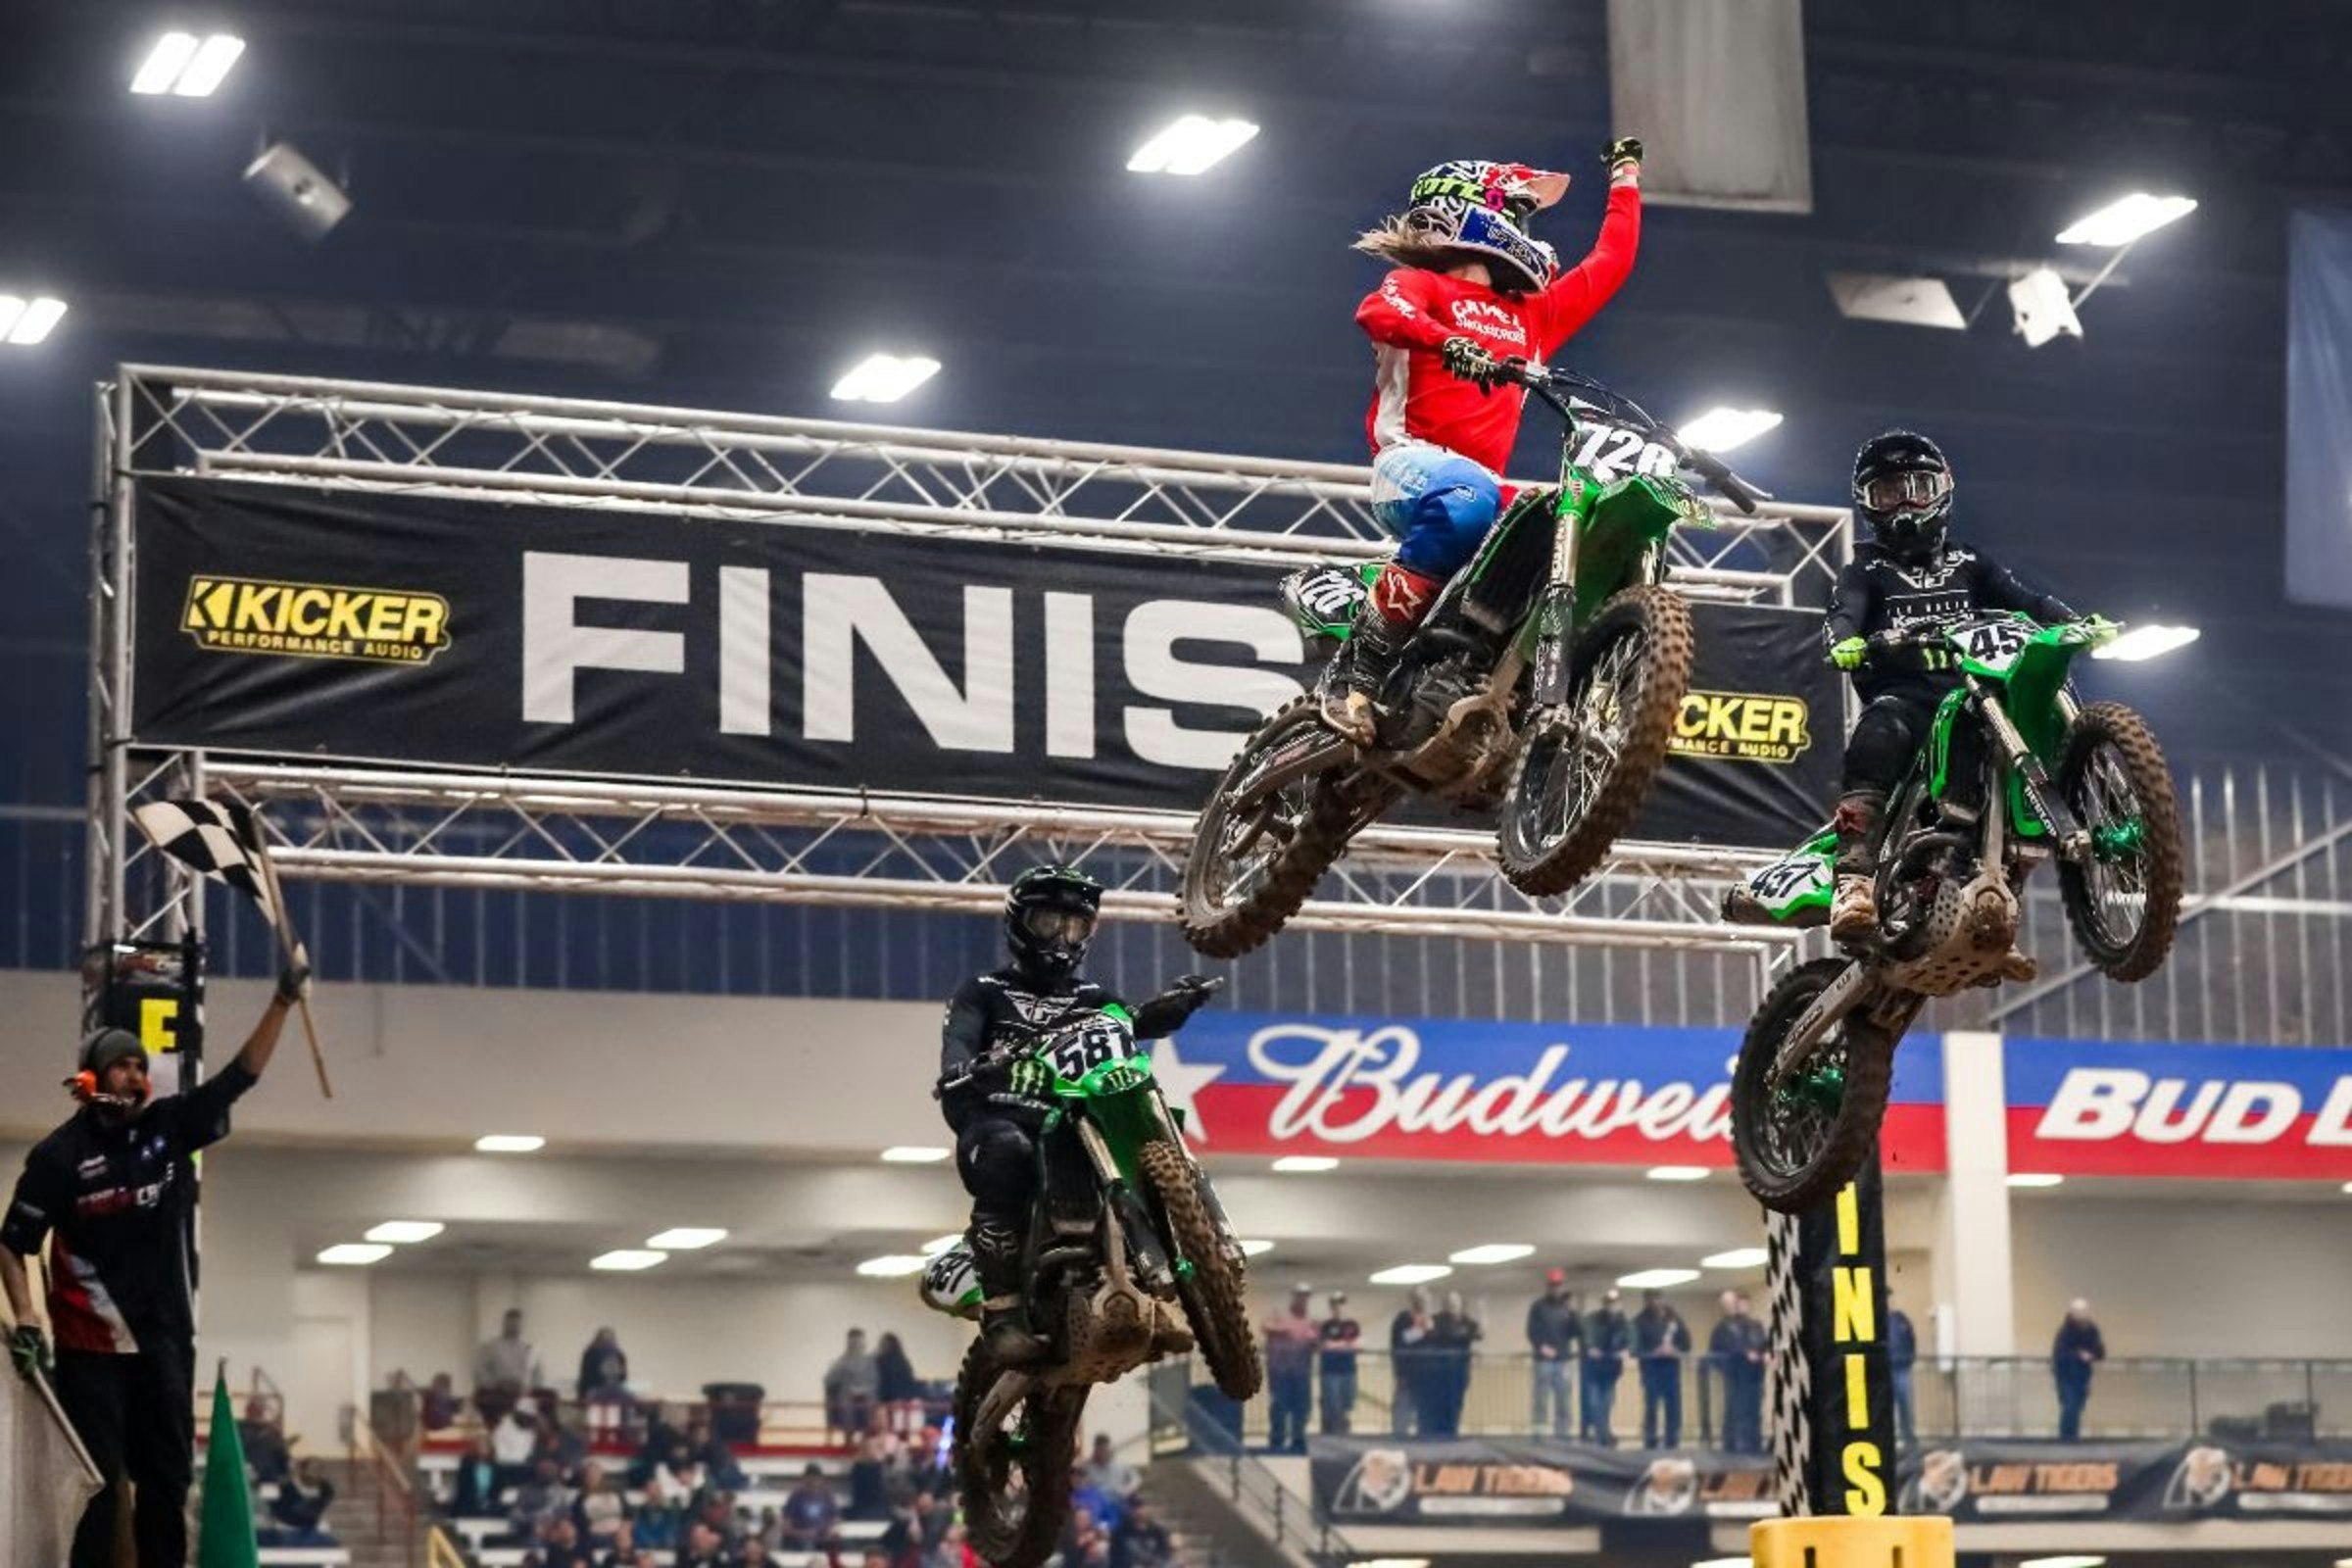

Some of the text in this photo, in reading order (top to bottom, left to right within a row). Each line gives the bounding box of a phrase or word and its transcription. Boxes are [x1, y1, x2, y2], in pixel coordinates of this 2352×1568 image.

[235, 583, 444, 644] KICKER
[207, 629, 424, 660] PERFORMANCE AUDIO
[522, 551, 1306, 770] FINIS
[1667, 738, 1789, 758] MANCE AUDIO
[1675, 695, 1803, 744] CKER
[1248, 1024, 1740, 1143] Budwei
[2034, 1067, 2352, 1146] BUD L
